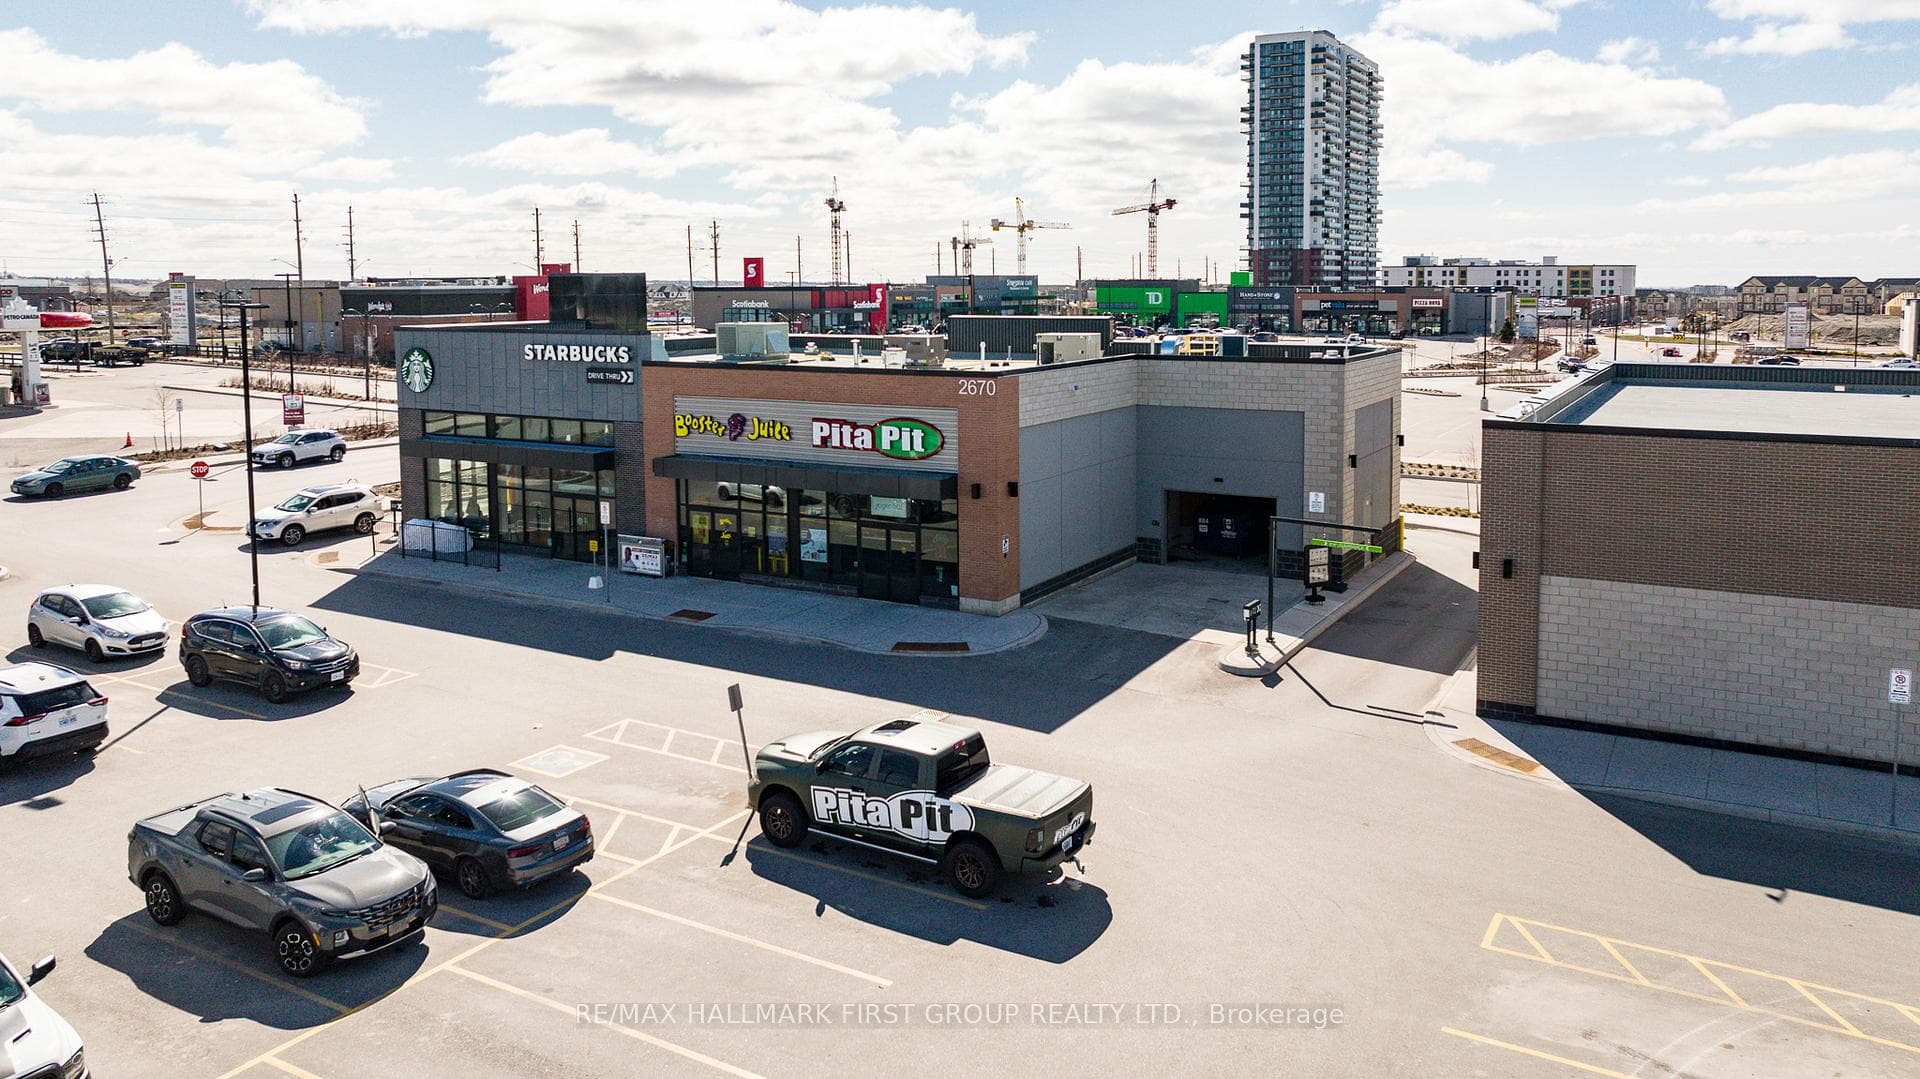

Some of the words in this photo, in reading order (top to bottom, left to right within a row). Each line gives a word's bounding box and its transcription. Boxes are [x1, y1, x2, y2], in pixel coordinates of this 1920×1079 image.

[533, 282, 550, 295] Wend
[731, 300, 769, 308] Scotiabank
[853, 300, 881, 309] Scotiabank
[1145, 292, 1162, 305] TD
[524, 344, 630, 363] STARBUCKS
[587, 371, 604, 380] DRIVE
[605, 372, 621, 381] THRU
[958, 379, 996, 396] 2670
[747, 416, 792, 441] Juice
[812, 420, 873, 449] Pita
[881, 424, 925, 453] Pit
[191, 466, 209, 474] STOP
[813, 788, 892, 830] Pita
[900, 798, 954, 833] Pit
